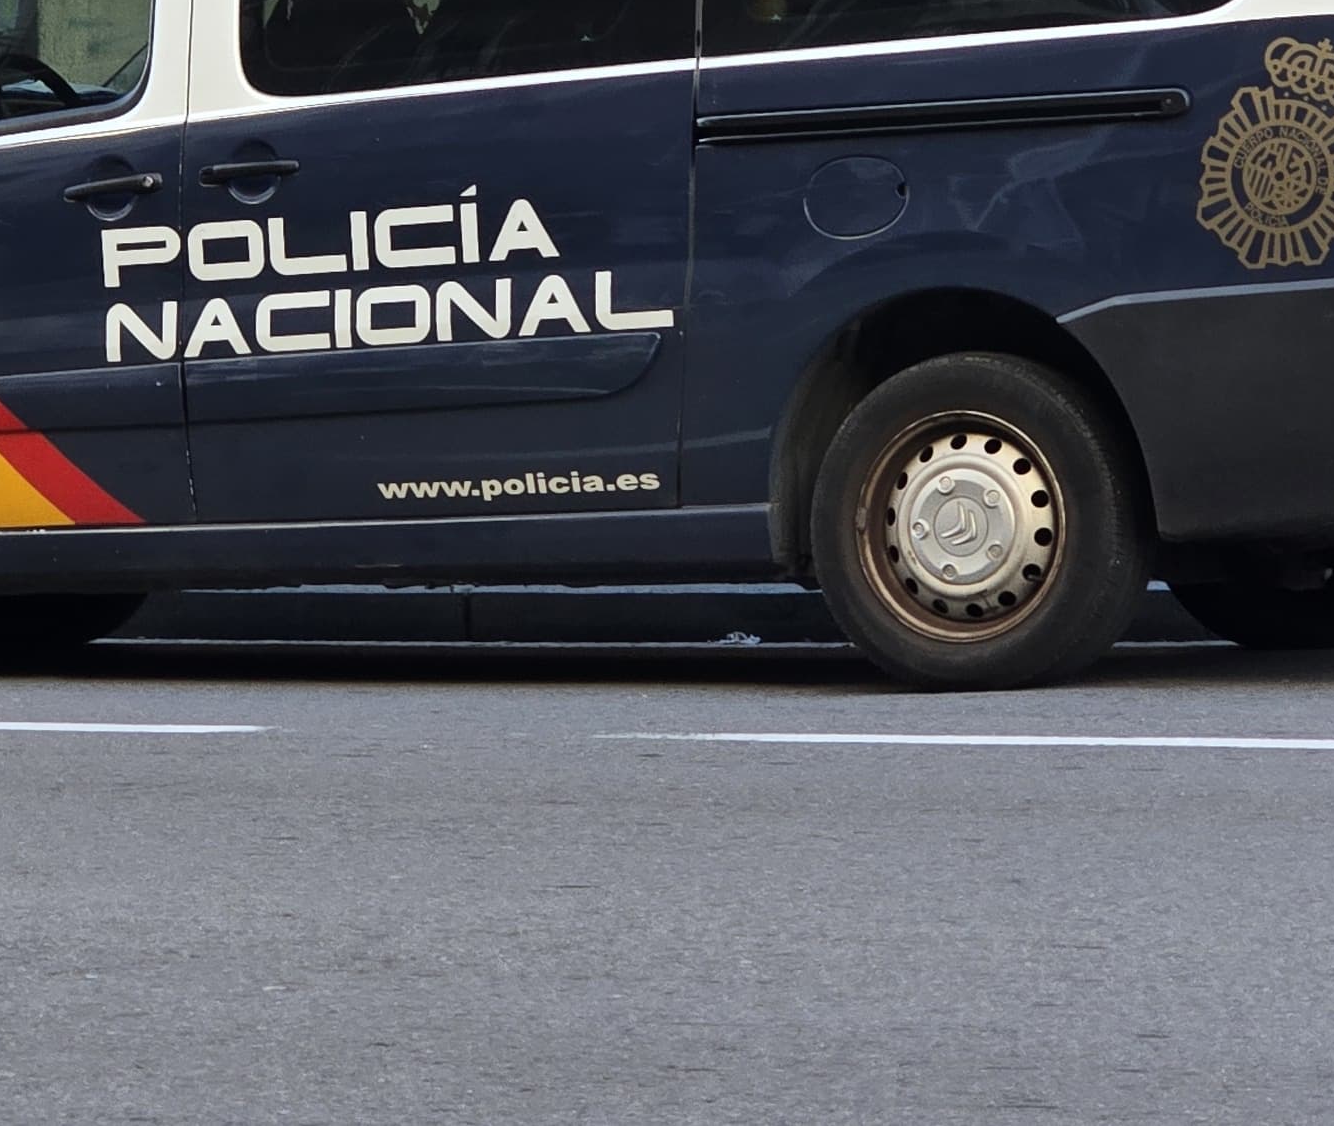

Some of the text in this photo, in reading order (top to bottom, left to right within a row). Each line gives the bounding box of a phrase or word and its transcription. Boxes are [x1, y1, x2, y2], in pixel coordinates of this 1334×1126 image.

[1233, 127, 1274, 169] CUERPO
[101, 184, 559, 287] POLICÍA
[105, 270, 674, 363] NACIONAL
[376, 469, 661, 502] www.policia.es
